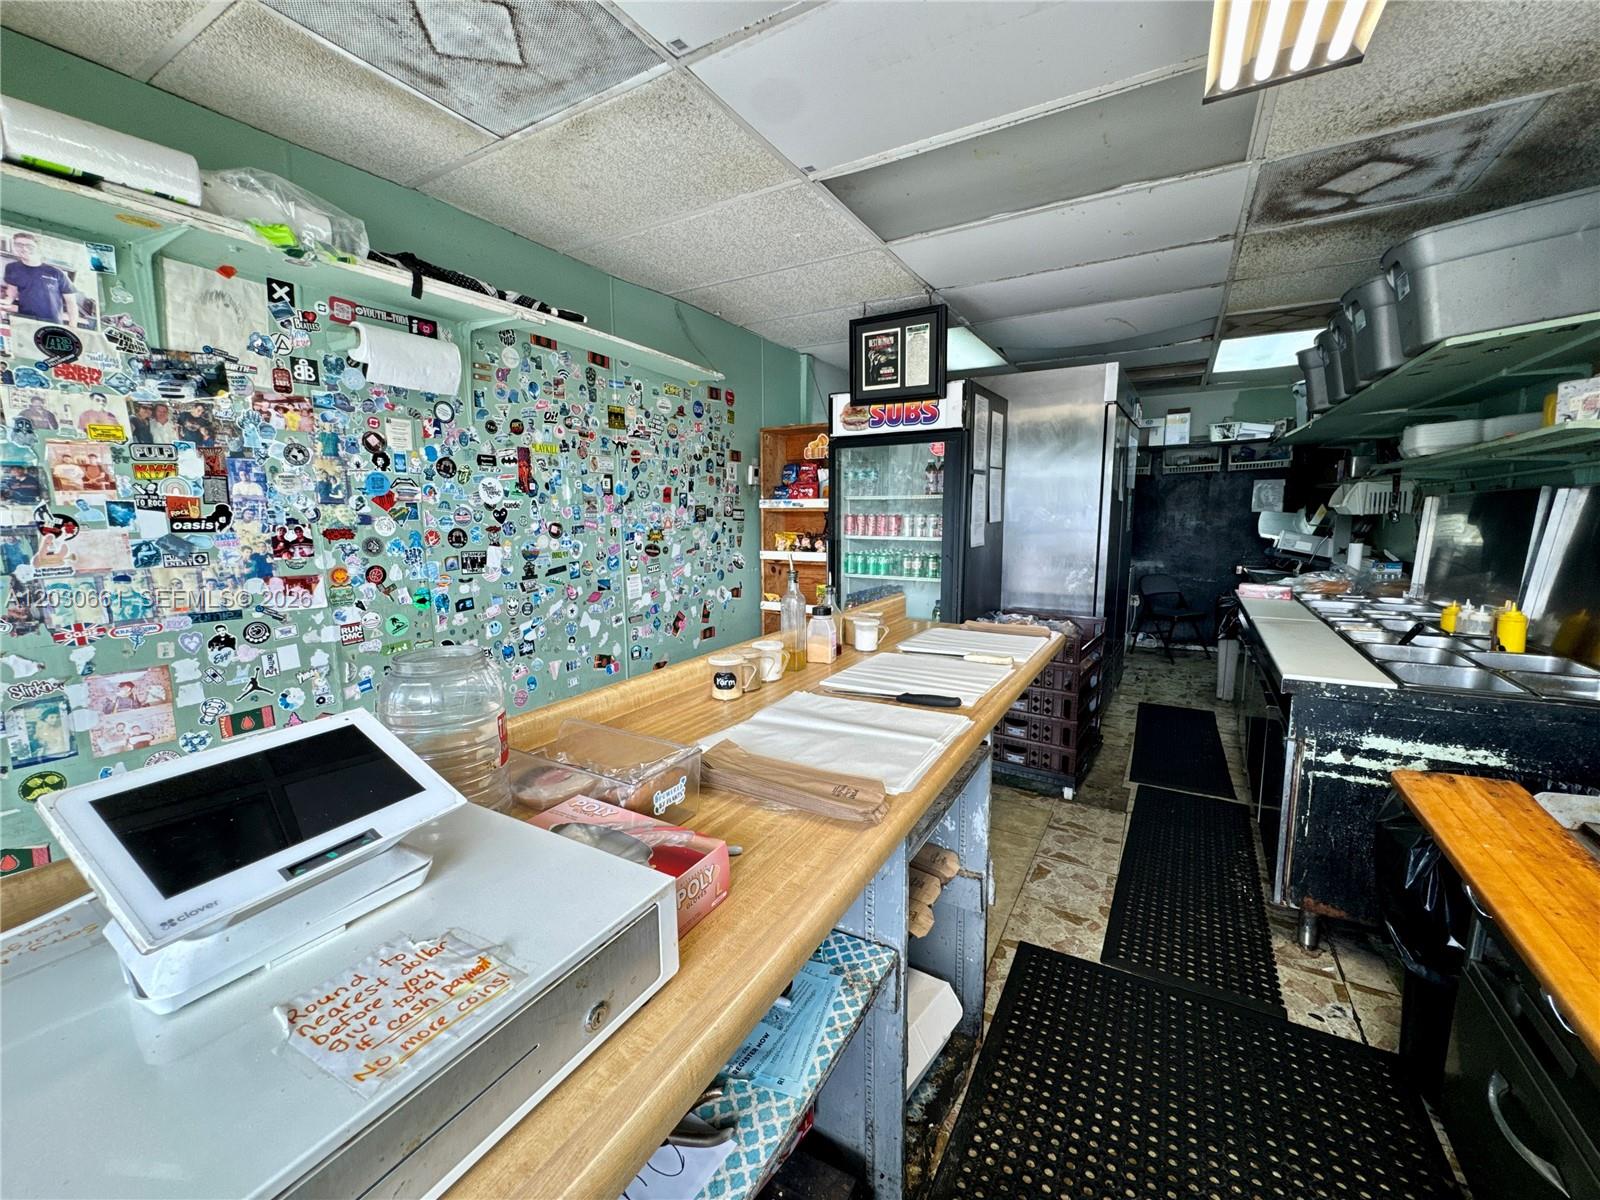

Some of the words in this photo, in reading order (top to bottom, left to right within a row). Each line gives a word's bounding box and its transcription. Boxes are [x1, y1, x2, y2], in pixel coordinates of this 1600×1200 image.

[295, 318, 320, 332] BEATLES
[544, 411, 558, 421] Oi!
[868, 400, 941, 428] SUBS
[134, 446, 175, 459] PULP
[172, 520, 214, 531] oasis
[341, 625, 362, 635] RUN
[342, 632, 363, 642] DMC
[658, 783, 684, 801] POWERED
[667, 792, 684, 806] PLANTS
[574, 799, 619, 818] POLY
[676, 863, 716, 910] POLY
[177, 899, 219, 922] clover
[287, 974, 368, 1025] Round
[379, 953, 406, 968] to
[296, 977, 390, 1038] nearest
[401, 940, 448, 976] dollar
[311, 998, 384, 1046] before
[396, 968, 437, 994] you
[328, 1016, 380, 1053] give
[391, 971, 446, 1009] total
[387, 996, 439, 1032] cash
[353, 1055, 392, 1083] No
[400, 1014, 448, 1052] more
[457, 971, 513, 1013] coins!
[732, 1045, 759, 1075] REGISTER
[757, 1032, 771, 1049] NOW
